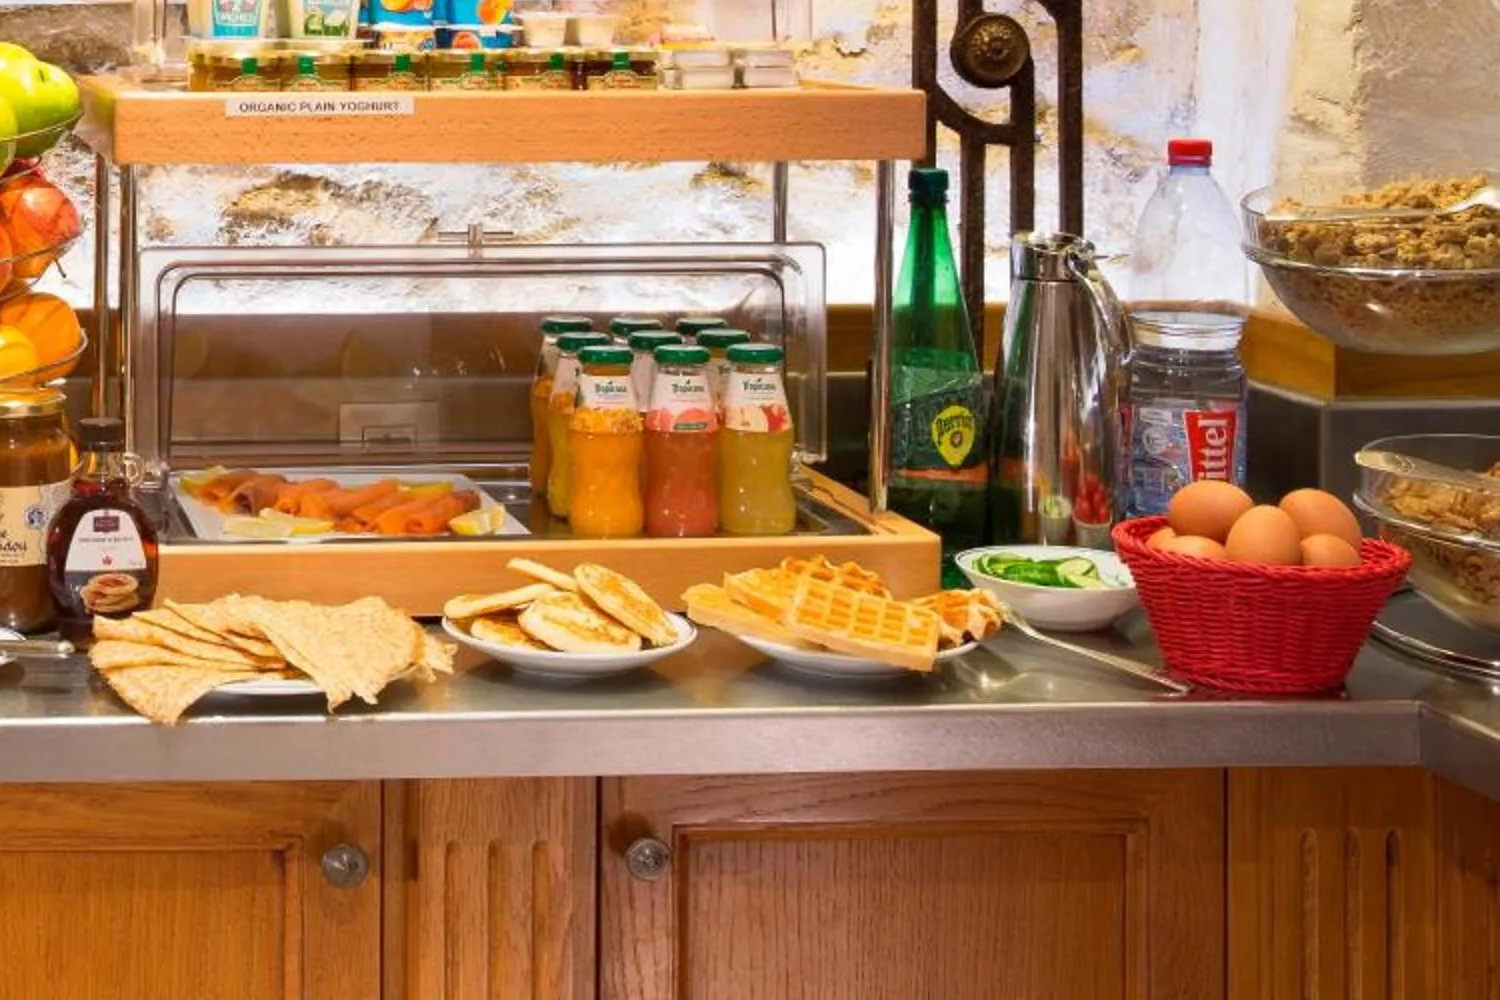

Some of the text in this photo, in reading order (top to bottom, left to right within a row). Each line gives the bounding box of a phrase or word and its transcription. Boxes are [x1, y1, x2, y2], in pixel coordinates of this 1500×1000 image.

[239, 101, 400, 113] ORGANIC PLAIN YOGHURT
[594, 381, 627, 394] Tropicana
[672, 380, 705, 394] Tropicana
[743, 378, 776, 391] Tropicana
[1197, 418, 1228, 480] ittel
